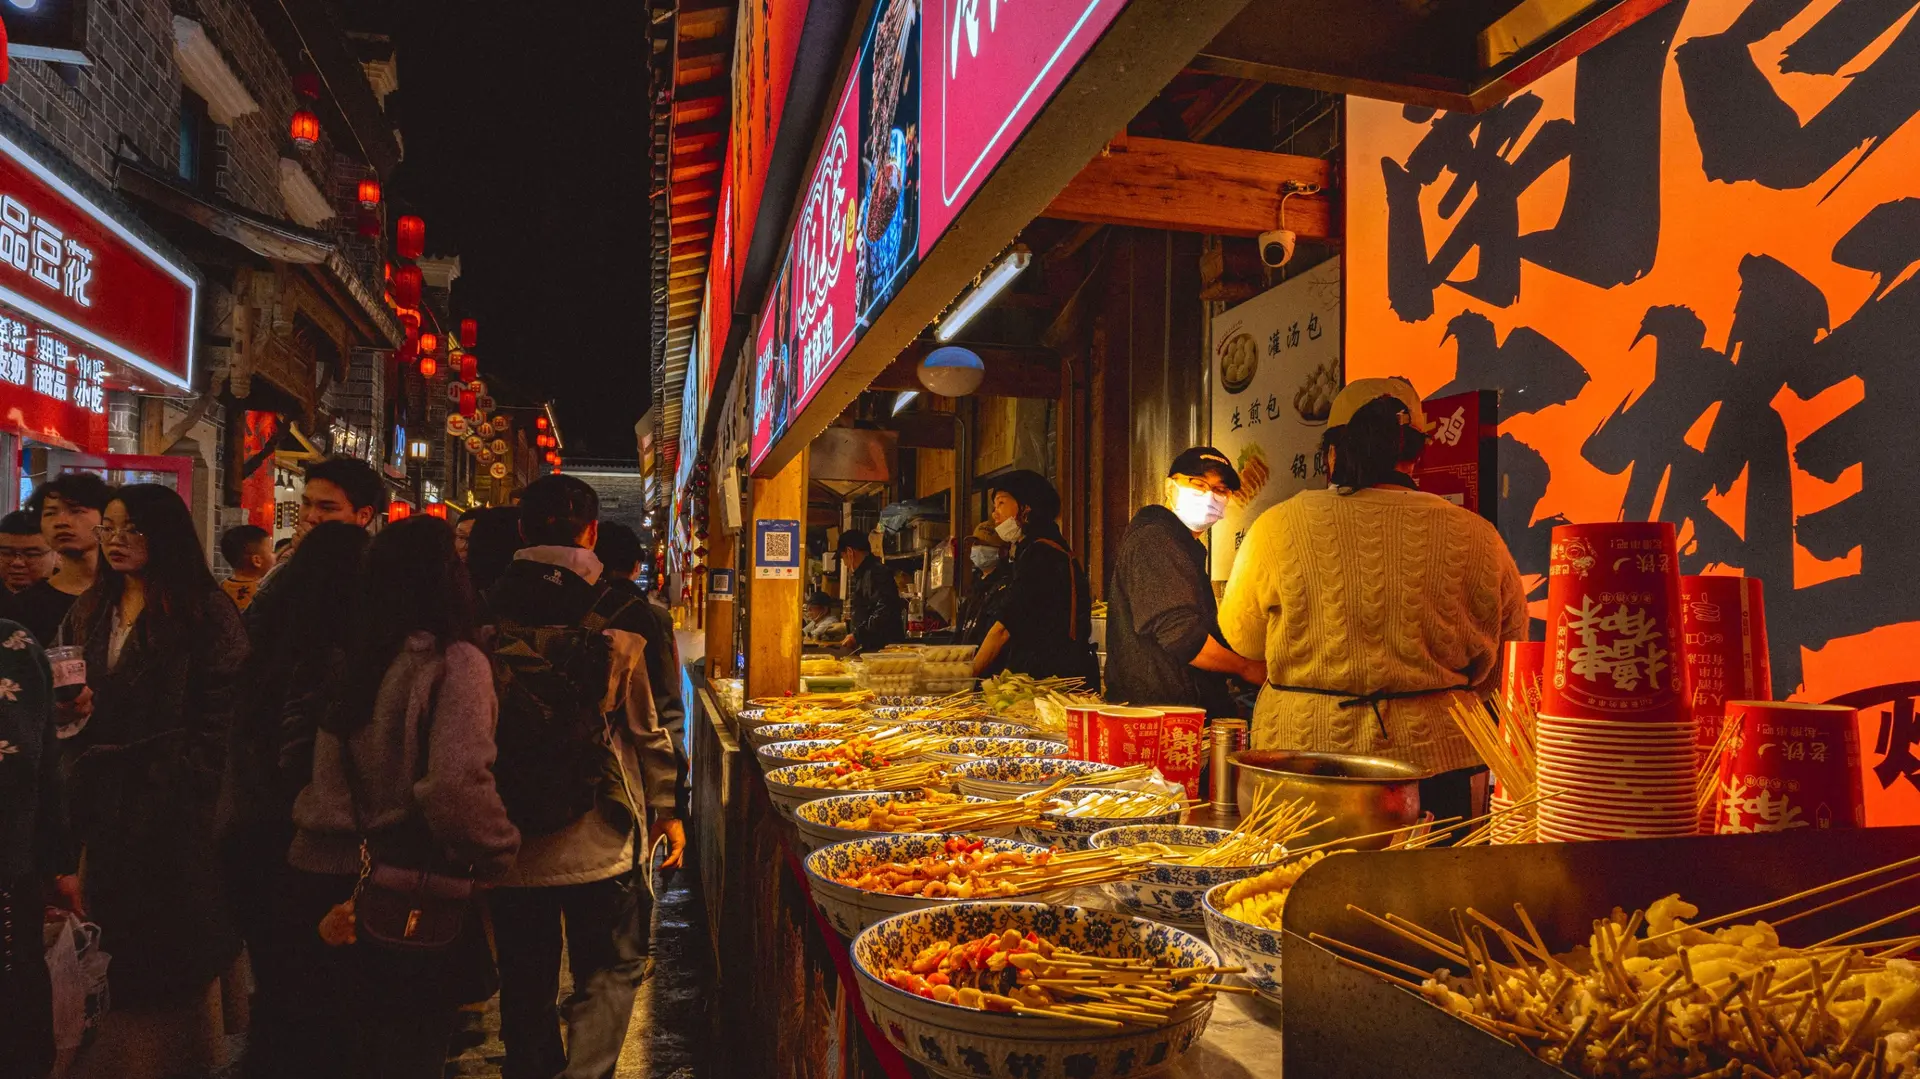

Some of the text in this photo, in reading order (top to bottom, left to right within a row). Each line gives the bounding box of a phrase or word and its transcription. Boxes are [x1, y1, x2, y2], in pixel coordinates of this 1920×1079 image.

[0, 194, 92, 307] 品豆花
[1268, 312, 1322, 357] 灌汤包
[74, 379, 104, 414] 小吃
[1231, 394, 1280, 432] 生煎包
[1423, 405, 1466, 447] 鸡
[1635, 554, 1671, 573] 老铁
[1697, 693, 1723, 706] 人生
[1780, 740, 1830, 762] 老铁
